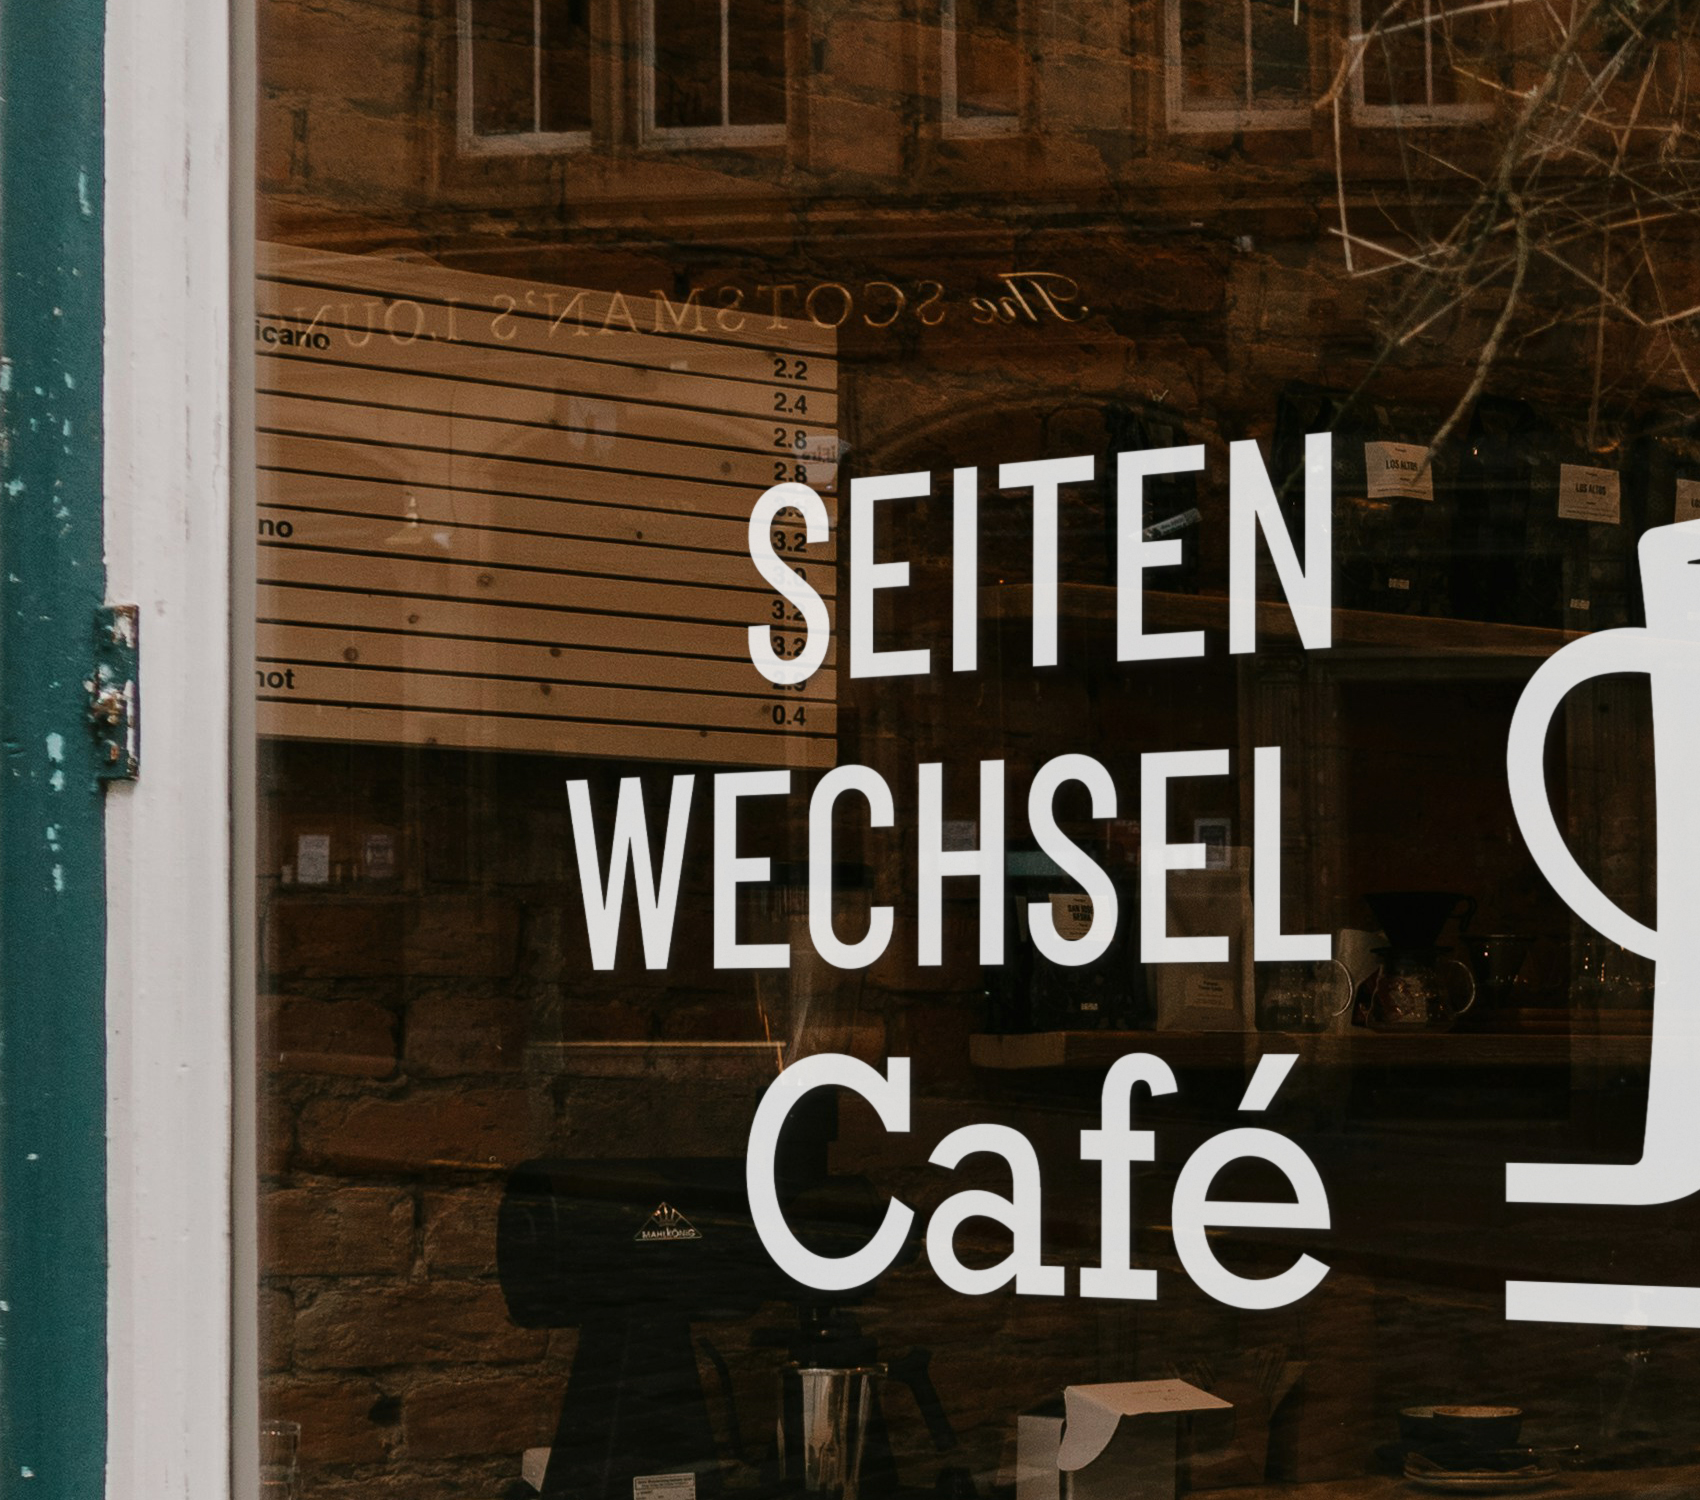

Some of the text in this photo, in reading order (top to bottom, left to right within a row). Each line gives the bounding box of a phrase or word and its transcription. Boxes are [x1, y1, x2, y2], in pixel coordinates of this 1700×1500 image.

[773, 357, 808, 381] 2.2
[773, 391, 808, 415] 2.4
[773, 427, 808, 450] 2.8
[773, 461, 808, 484] 2.8
[772, 530, 808, 553] 3.2
[748, 432, 1332, 684] SEITEN
[772, 599, 807, 622] 3.2
[772, 635, 807, 657] 3.2
[772, 704, 808, 726] 0.4
[566, 746, 1332, 970] WECHSEL
[746, 1052, 1331, 1309] Café
